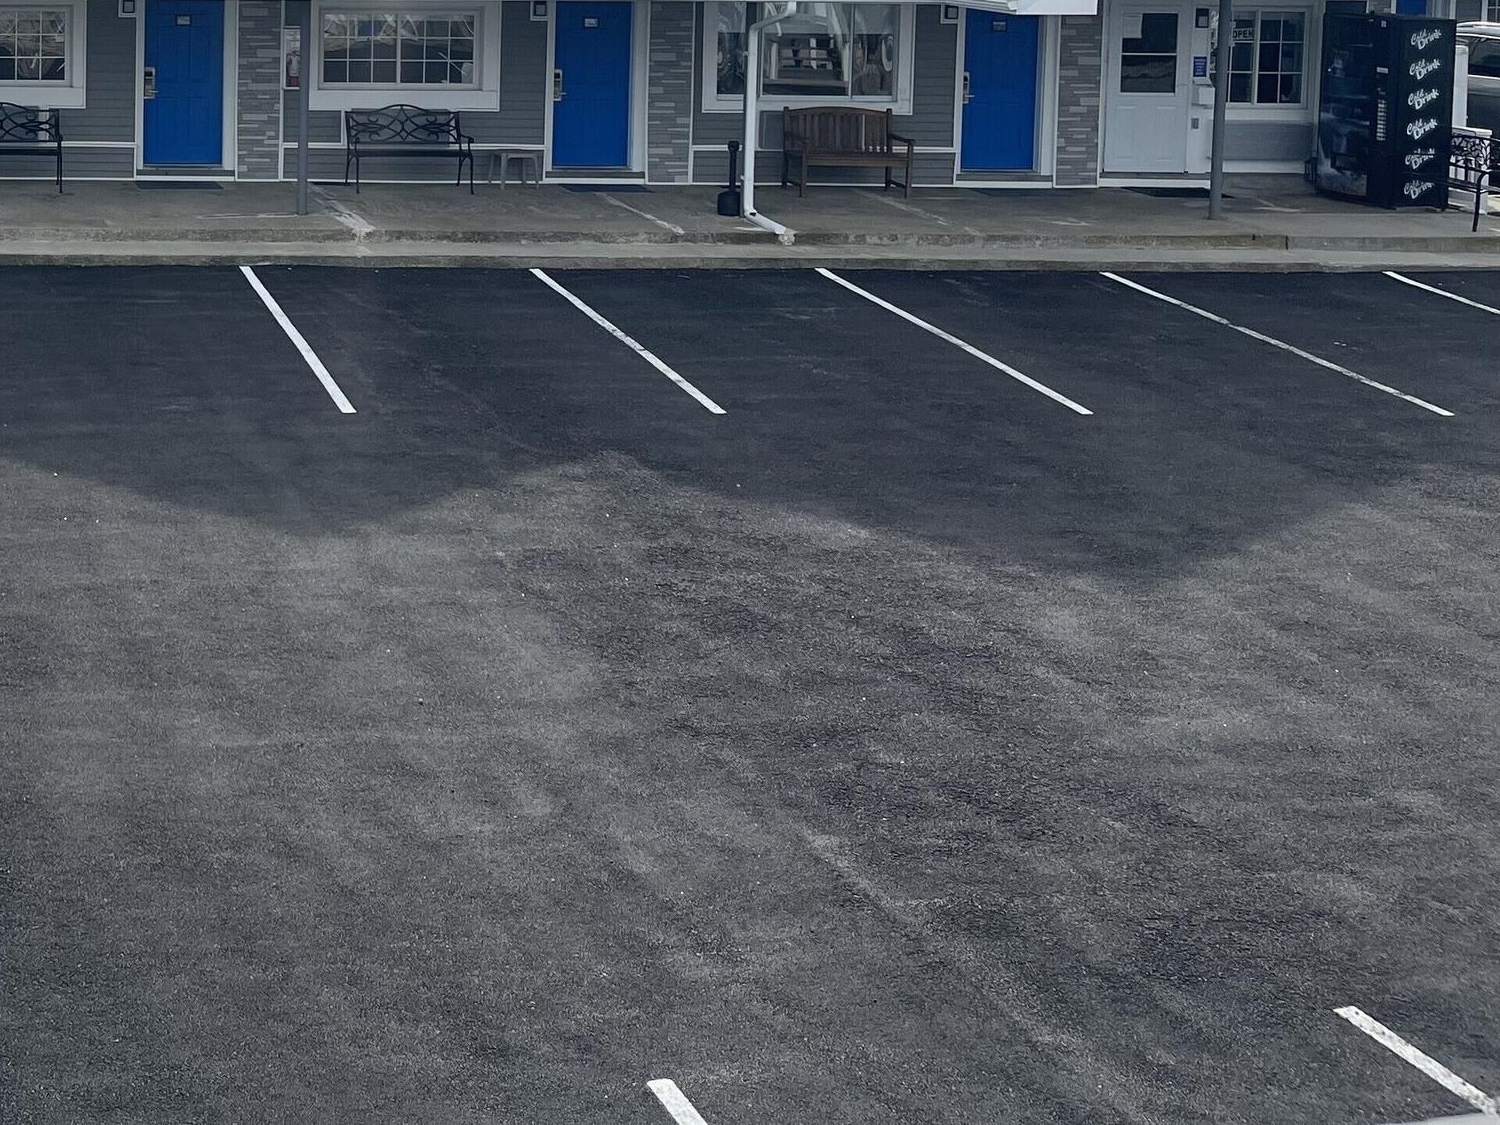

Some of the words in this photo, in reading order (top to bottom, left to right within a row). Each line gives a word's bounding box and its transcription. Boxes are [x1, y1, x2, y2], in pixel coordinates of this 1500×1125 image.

[1411, 29, 1427, 45] Cold
[1417, 29, 1441, 50] Drink
[1409, 59, 1425, 75] Cold
[1416, 59, 1440, 80] Drink
[1408, 88, 1424, 105] Cold
[1414, 88, 1439, 110] Drink
[1406, 118, 1423, 135] Cold
[1413, 118, 1438, 139] Drink
